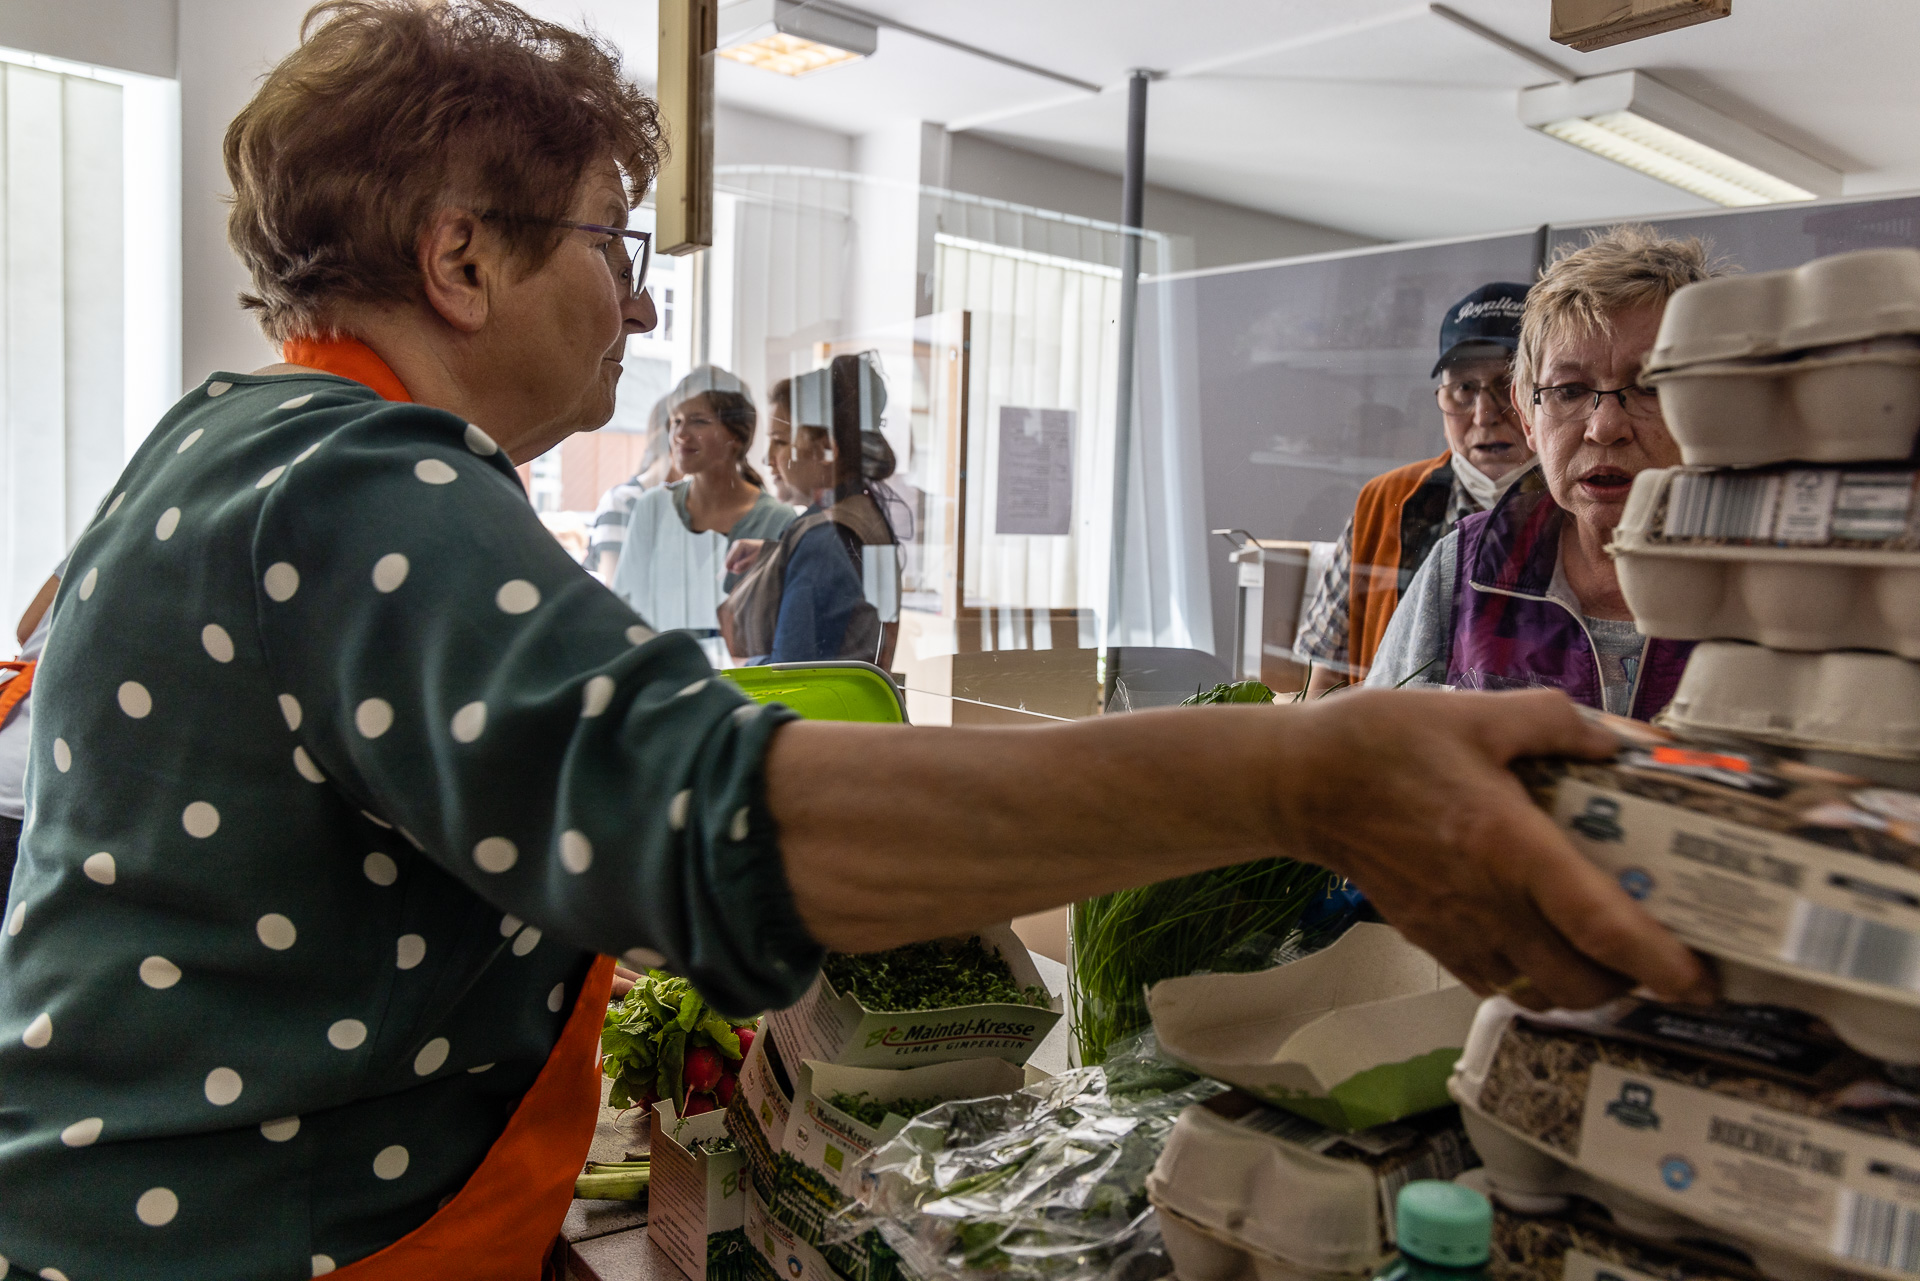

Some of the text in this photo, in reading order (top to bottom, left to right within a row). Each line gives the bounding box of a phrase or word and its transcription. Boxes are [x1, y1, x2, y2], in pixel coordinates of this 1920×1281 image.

[904, 1018, 1035, 1041] Maintal-Kresse
[895, 1039, 1025, 1055] ELMAR GIMPERLEIN
